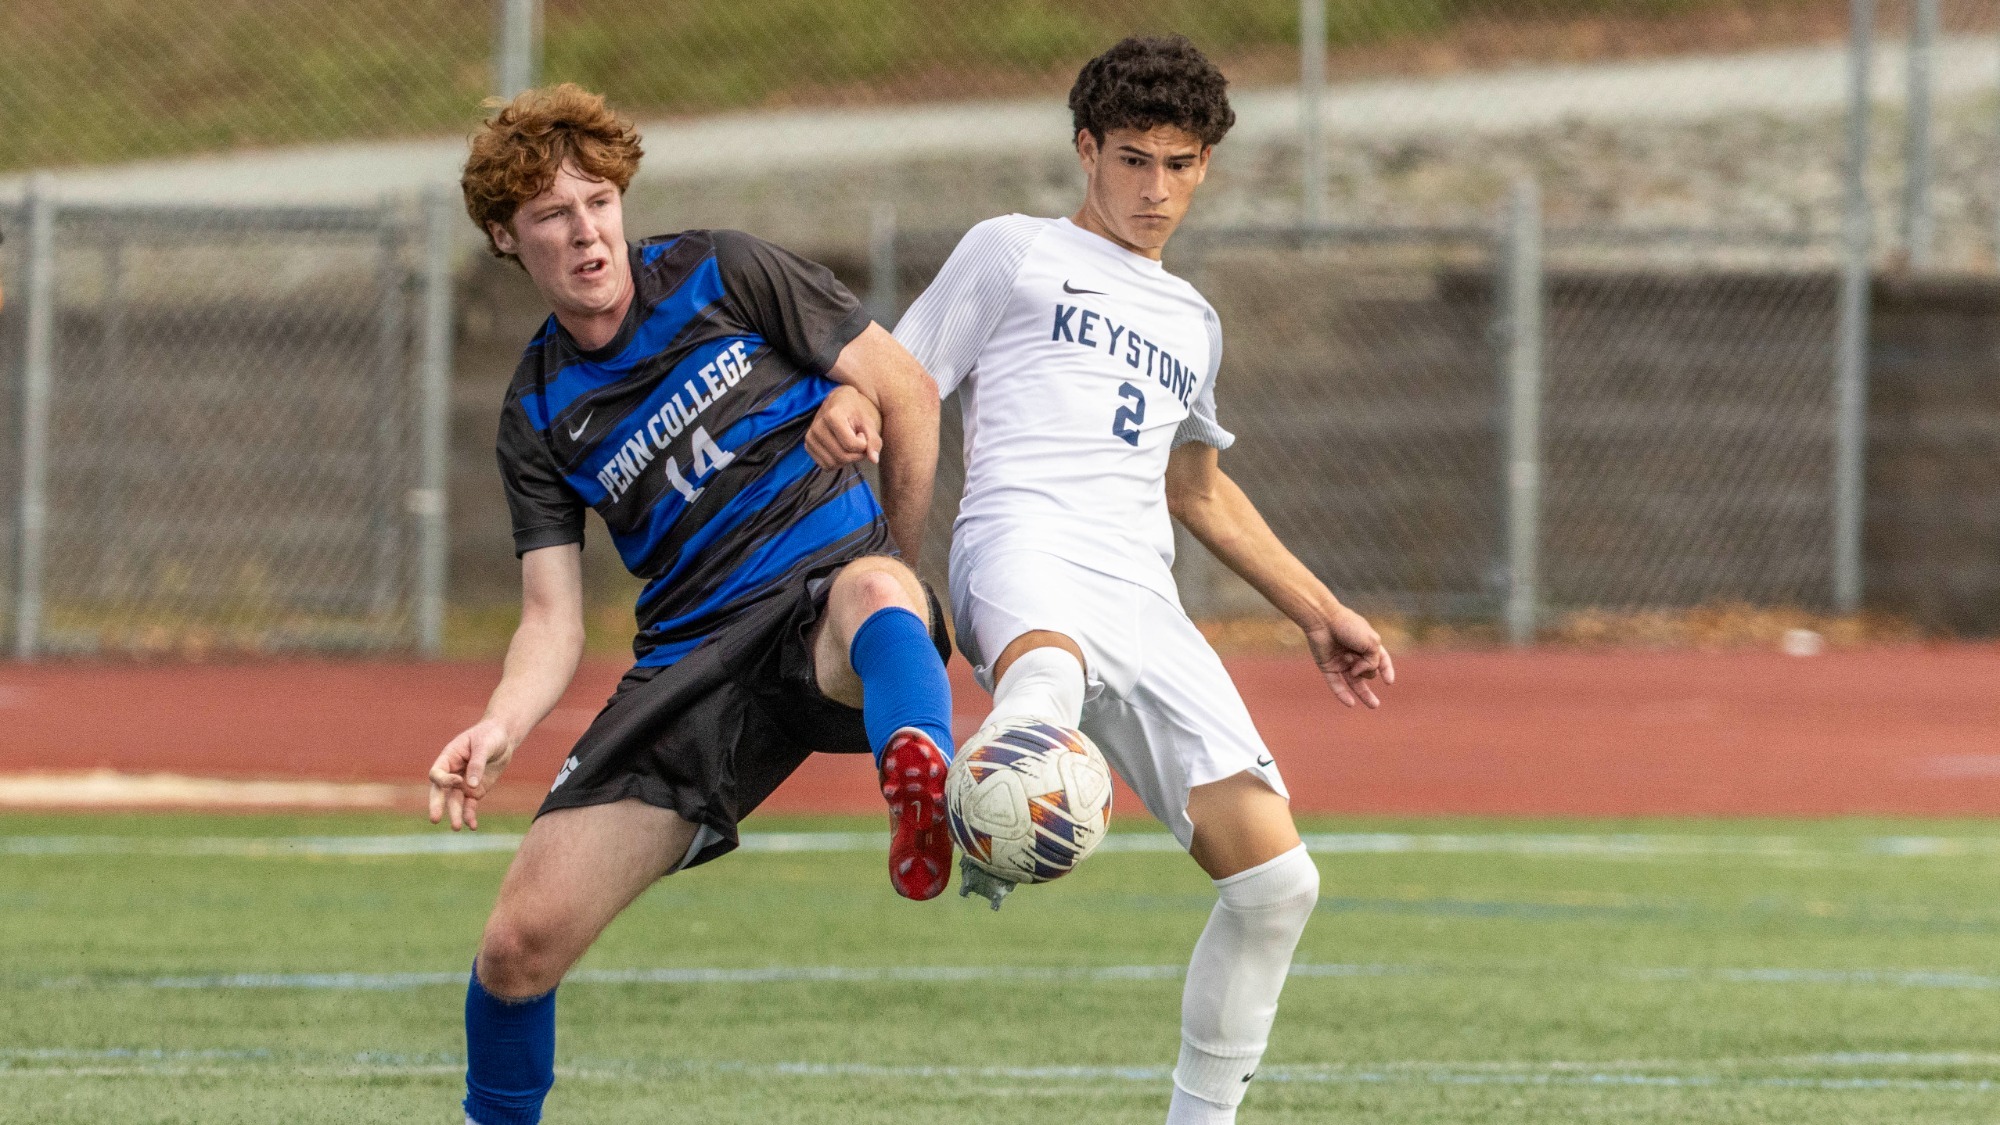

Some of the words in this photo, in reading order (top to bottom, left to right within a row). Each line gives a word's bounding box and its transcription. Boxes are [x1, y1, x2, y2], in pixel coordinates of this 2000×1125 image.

[1052, 304, 1197, 411] KEYSTONE
[597, 429, 655, 503] PENN
[647, 340, 753, 450] COLLEGE
[1112, 381, 1146, 447] 2
[665, 425, 736, 504] 14
